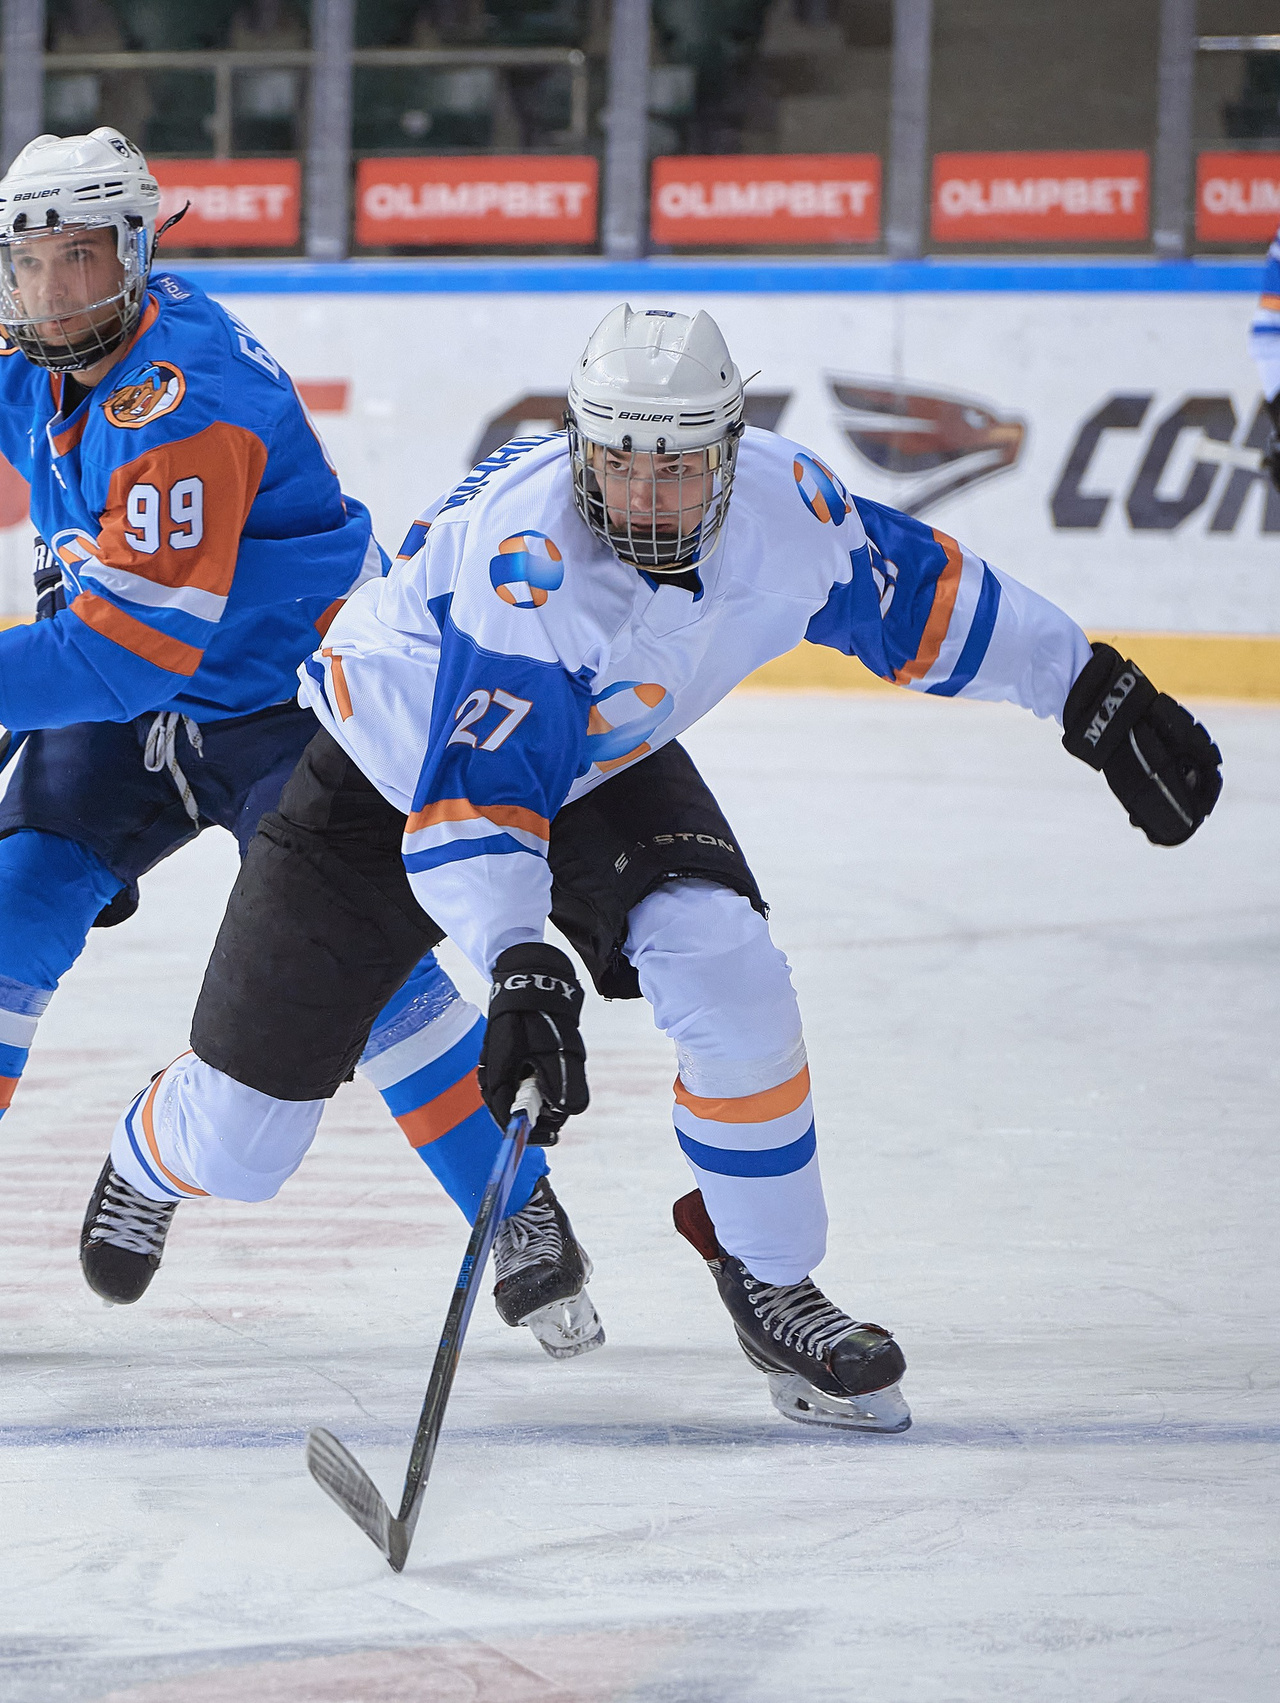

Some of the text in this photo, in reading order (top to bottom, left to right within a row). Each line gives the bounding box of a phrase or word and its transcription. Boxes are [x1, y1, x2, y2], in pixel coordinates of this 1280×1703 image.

[13, 188, 61, 202] BAUER
[361, 182, 591, 219] OLIMPBET
[657, 181, 871, 219] OLIMPBET
[939, 178, 1141, 216] OLIMPBET
[618, 411, 674, 423] BAUER
[124, 475, 204, 554] 99
[446, 688, 533, 753] 27
[1083, 672, 1137, 747] MAD
[614, 832, 736, 875] ESTON
[503, 973, 576, 1001] GUY
